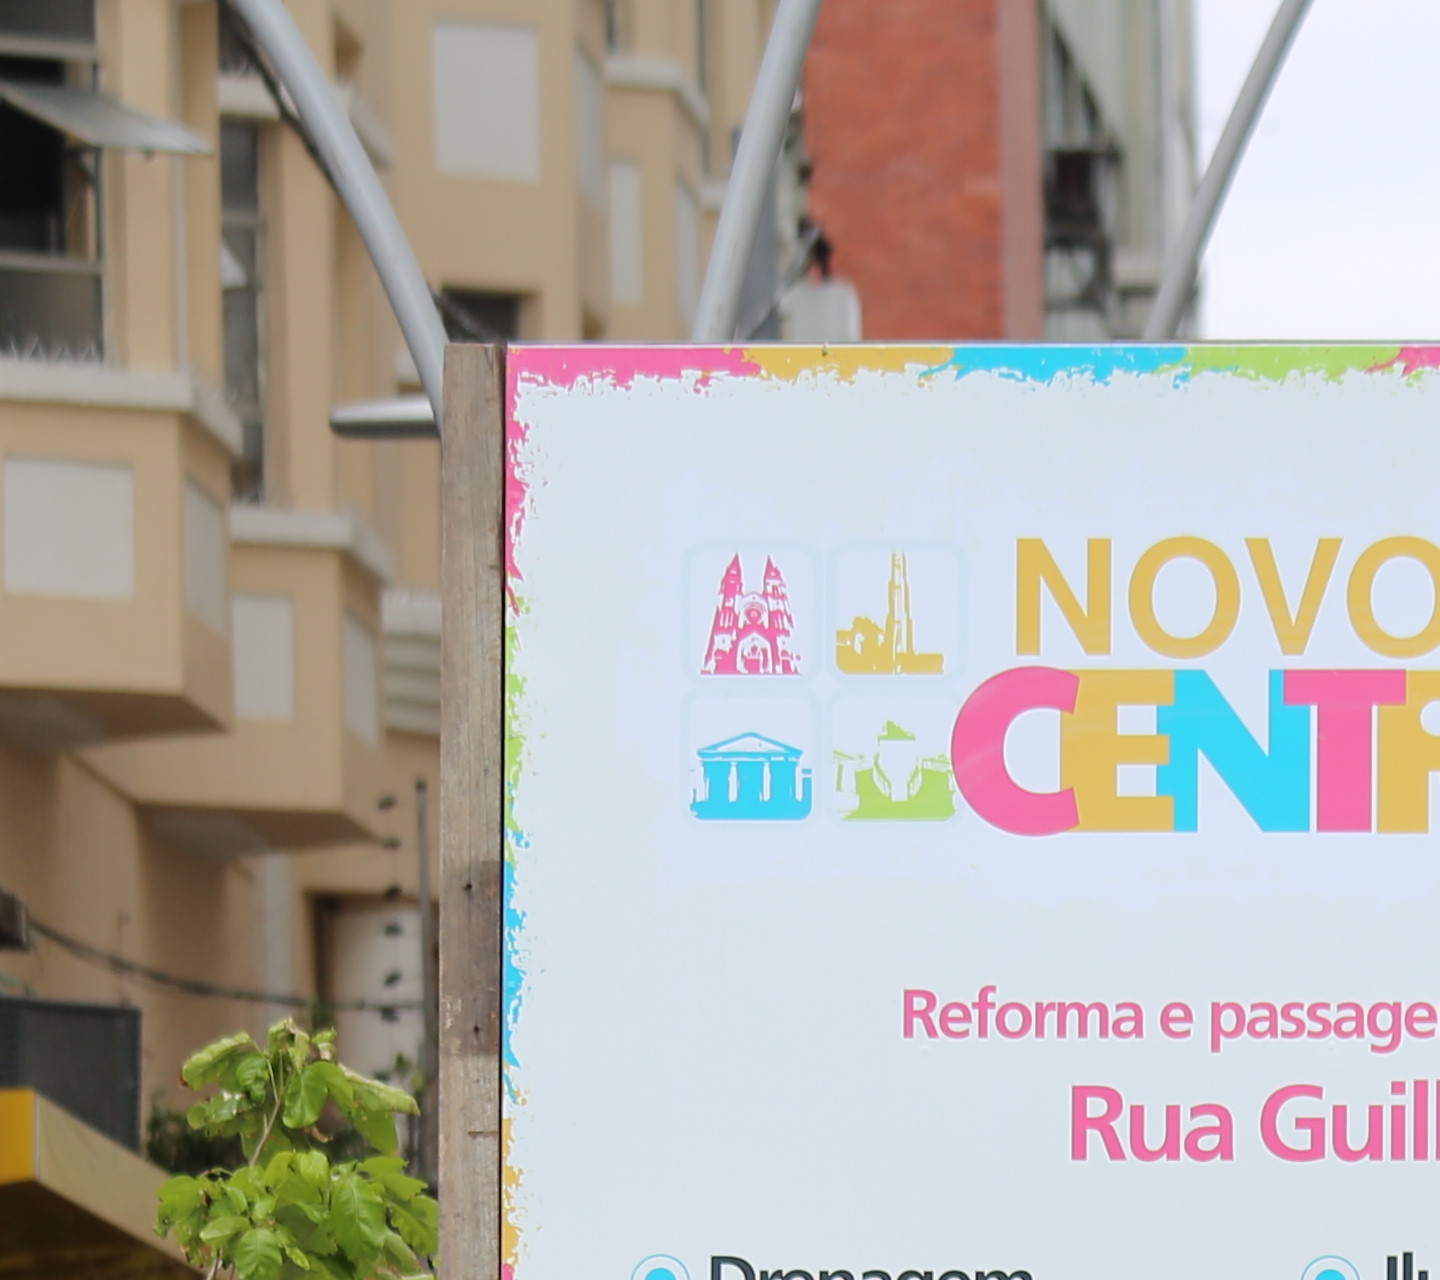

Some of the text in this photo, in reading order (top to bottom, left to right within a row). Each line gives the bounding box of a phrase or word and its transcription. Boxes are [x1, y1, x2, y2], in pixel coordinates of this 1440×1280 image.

[903, 987, 1145, 1039] Reforma
[1160, 1002, 1195, 1039] e
[1071, 1085, 1235, 1162] Rua
